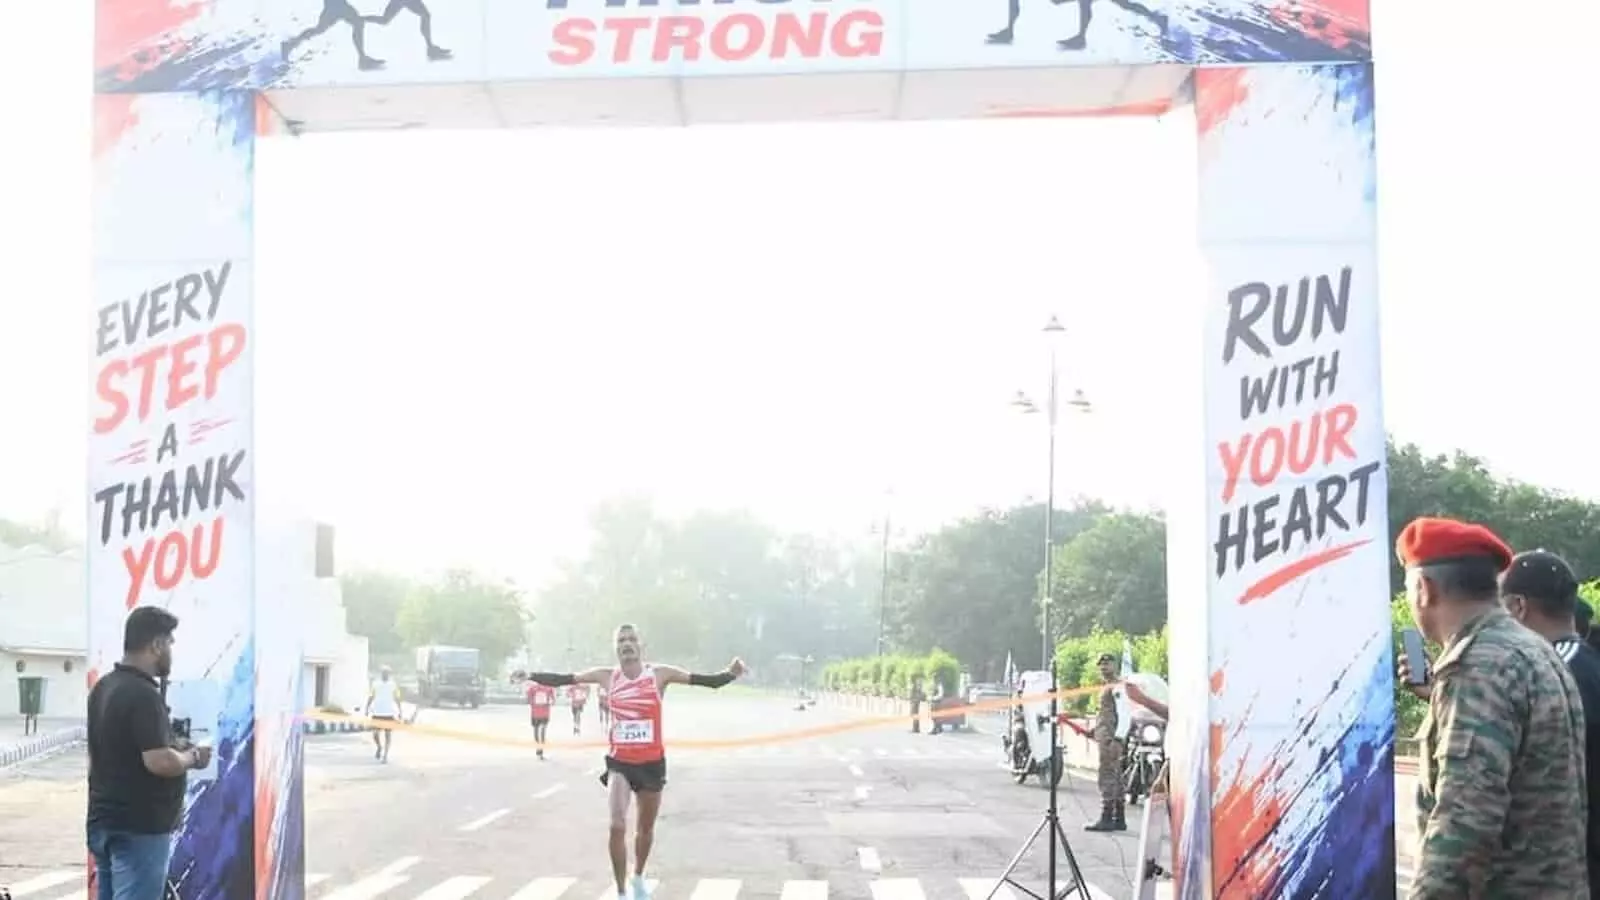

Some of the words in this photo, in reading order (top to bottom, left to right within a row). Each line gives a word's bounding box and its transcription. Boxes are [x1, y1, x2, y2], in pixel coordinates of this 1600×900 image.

[548, 10, 884, 65] STRONG
[96, 261, 232, 357] EVERY
[1222, 266, 1352, 364] RUN
[93, 322, 246, 435] STEP
[1240, 350, 1340, 420] WITH
[157, 423, 178, 463] A
[1218, 404, 1357, 503] YOUR
[95, 448, 246, 547] THANK
[1214, 461, 1380, 579] HEART
[122, 517, 224, 608] YOU
